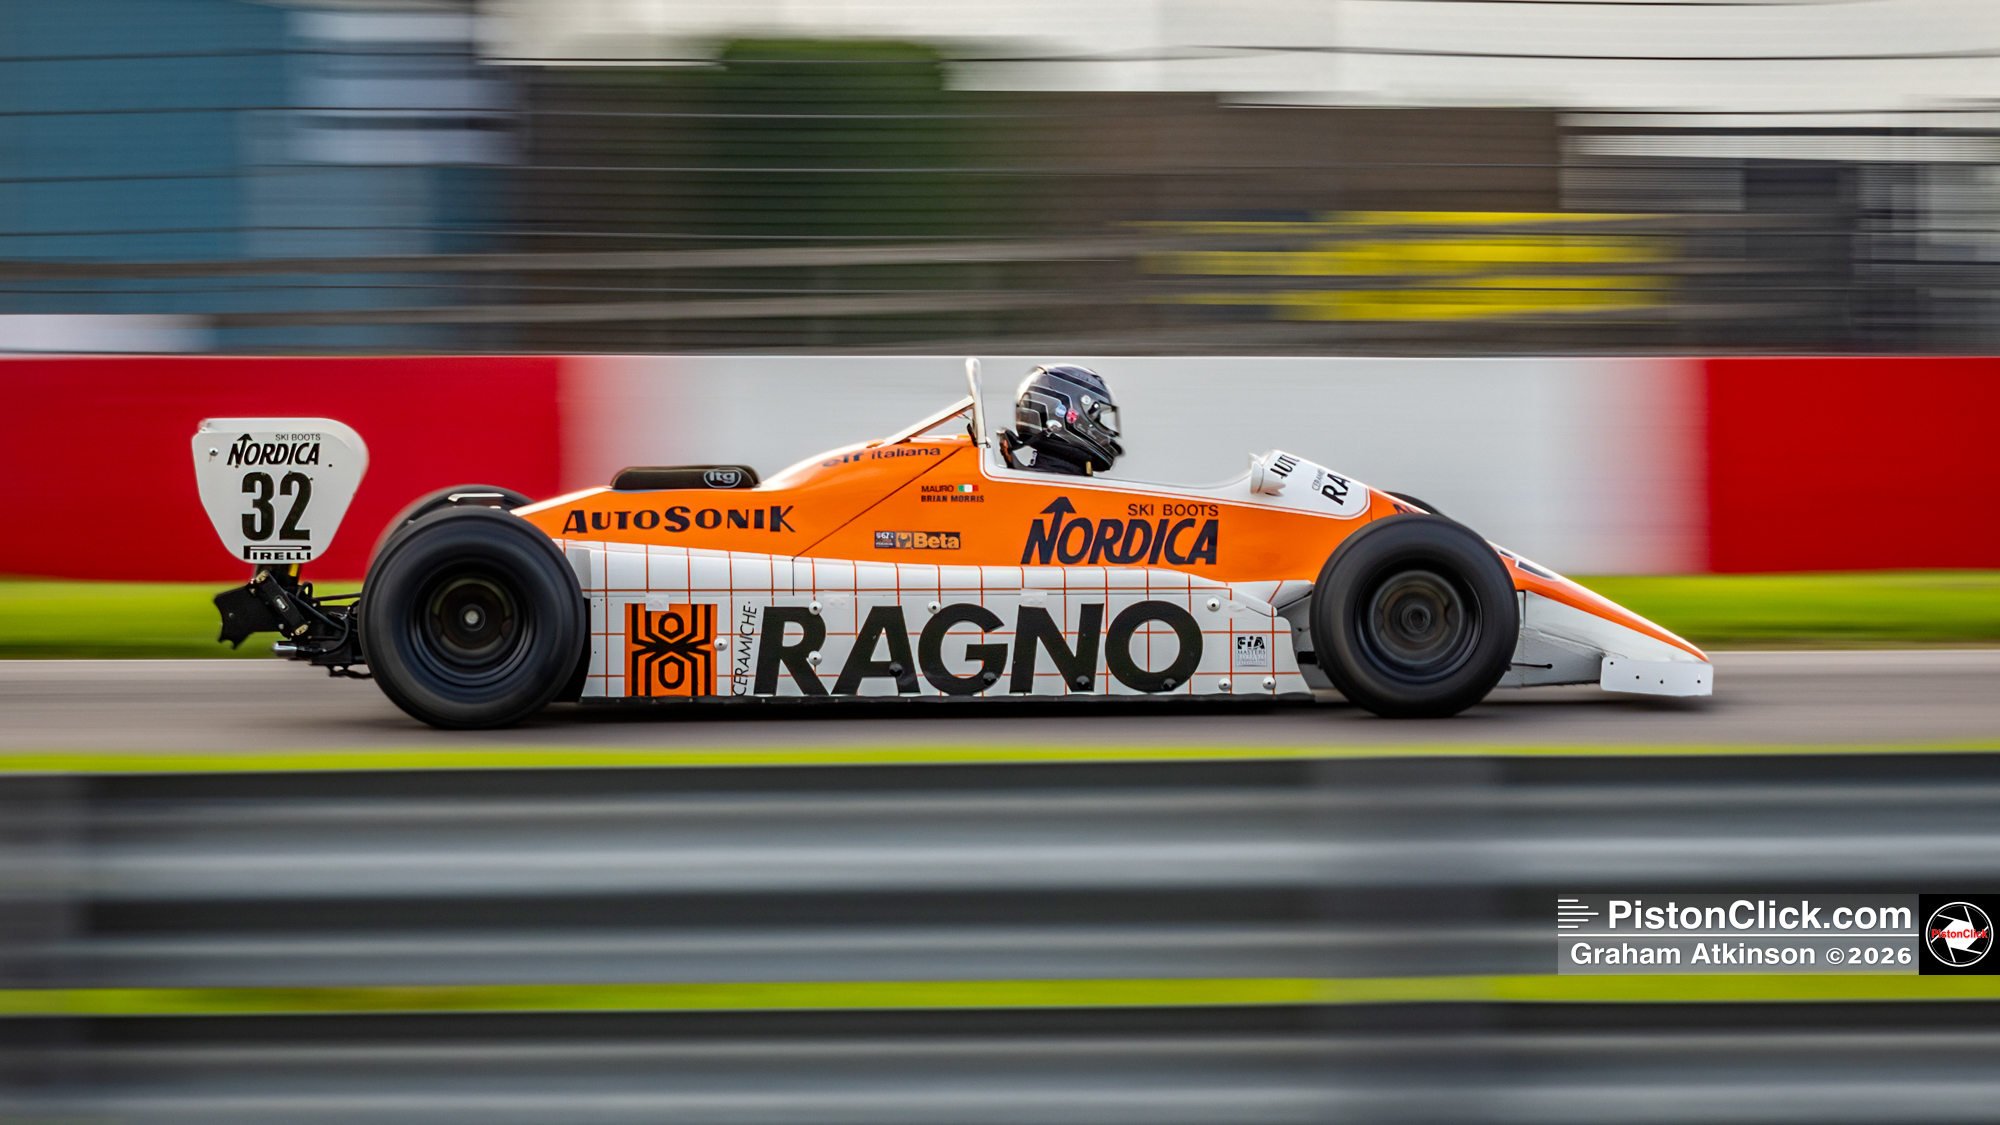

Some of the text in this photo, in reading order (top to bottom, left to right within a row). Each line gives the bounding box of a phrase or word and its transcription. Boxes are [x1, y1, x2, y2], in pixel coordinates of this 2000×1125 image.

[227, 434, 320, 466] NORDICA
[871, 448, 941, 460] italiana
[921, 485, 954, 493] MAURO
[241, 471, 312, 541] 32
[1128, 504, 1219, 516] SKI BOOTS
[914, 532, 960, 549] Beta
[1020, 496, 1218, 565] NORDICA
[244, 546, 312, 561] PIRELLI
[732, 605, 757, 696] CERAMICHE
[753, 600, 1203, 696] RAGNO
